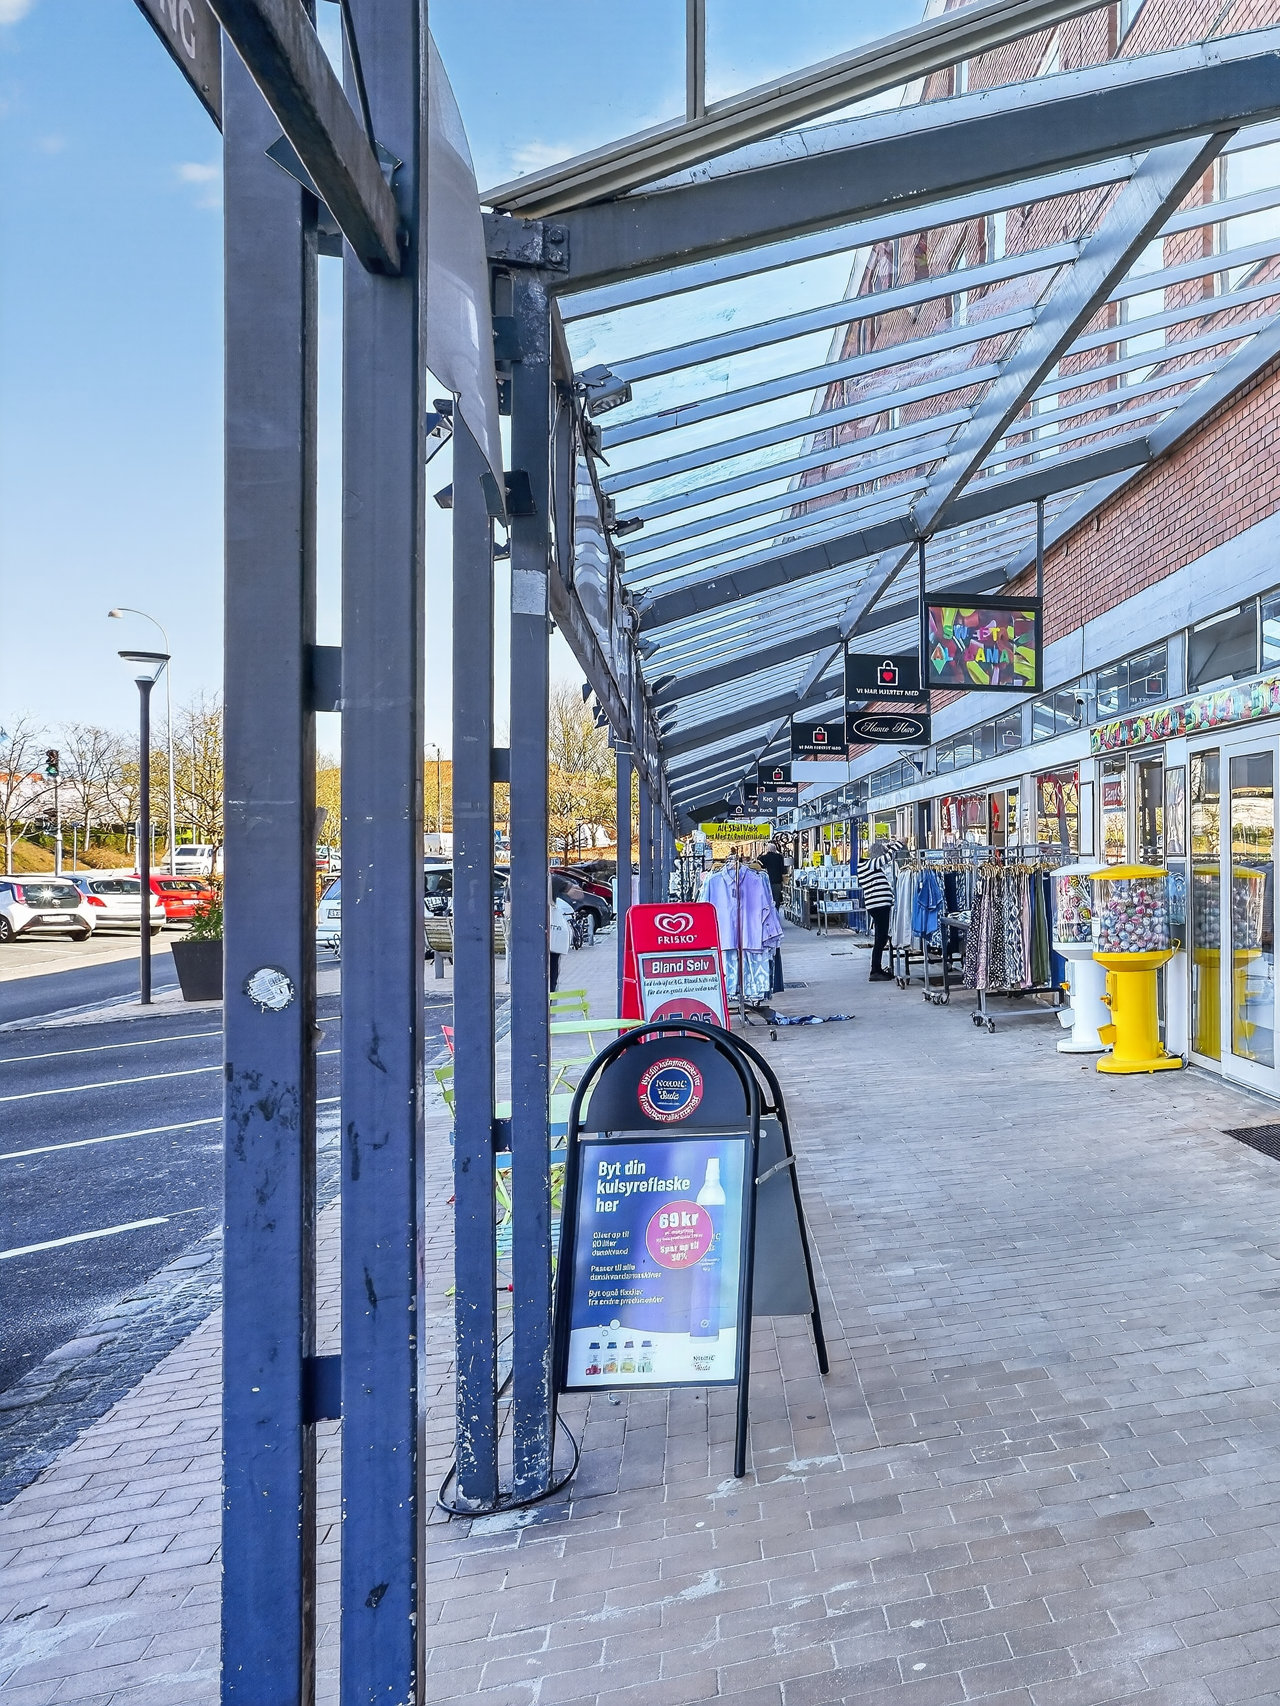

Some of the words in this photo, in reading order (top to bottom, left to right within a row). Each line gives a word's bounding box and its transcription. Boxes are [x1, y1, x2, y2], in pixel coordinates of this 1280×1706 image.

[657, 935, 695, 945] FRISKO
[651, 960, 684, 974] Bland
[686, 959, 710, 972] Selv
[598, 1161, 621, 1179] Byt
[624, 1159, 646, 1175] din
[596, 1176, 691, 1197] kulsyreflaske
[595, 1197, 620, 1213] her
[659, 1212, 680, 1229] 69
[681, 1211, 699, 1226] kr
